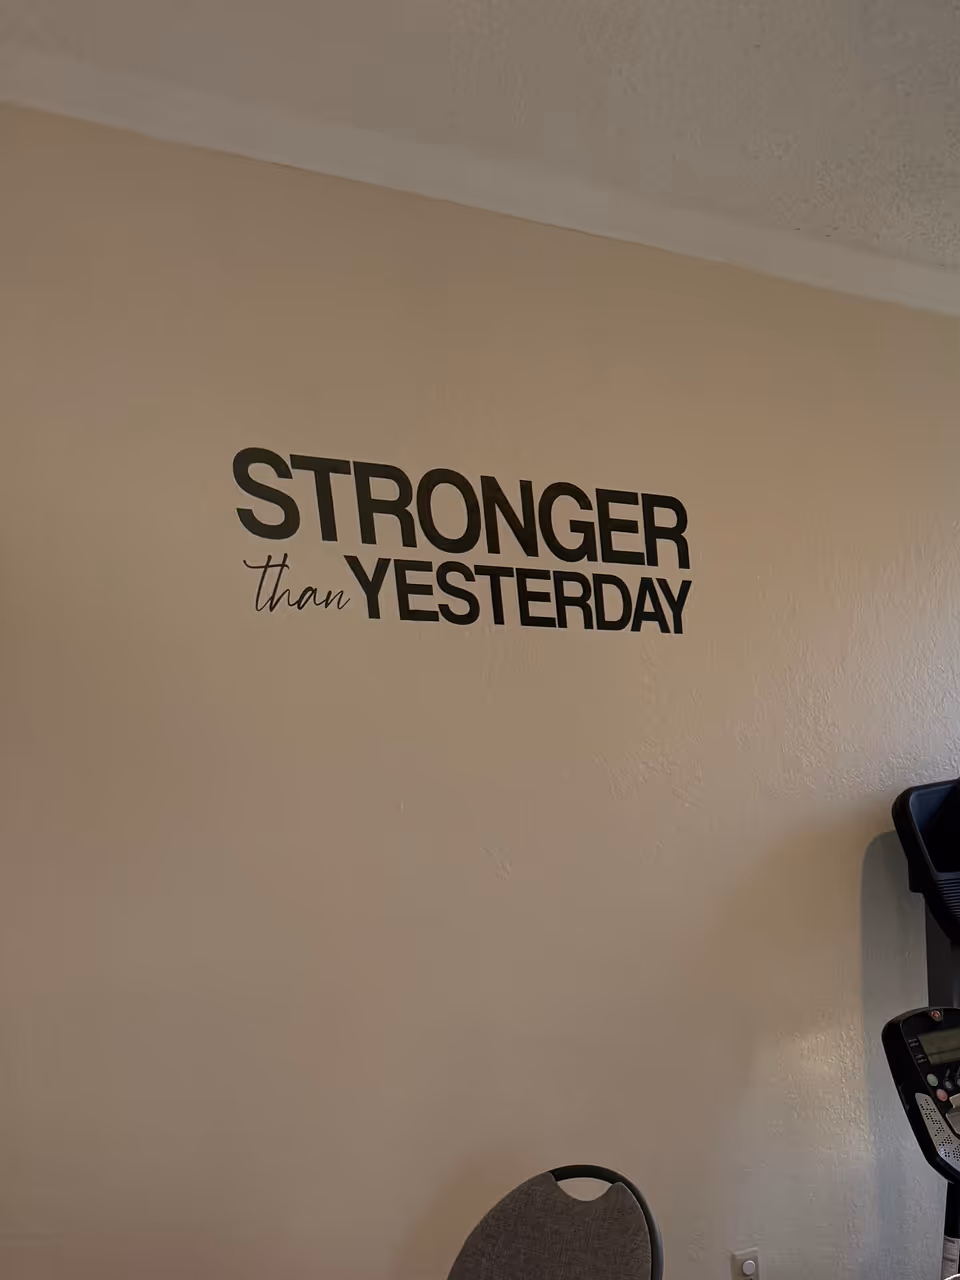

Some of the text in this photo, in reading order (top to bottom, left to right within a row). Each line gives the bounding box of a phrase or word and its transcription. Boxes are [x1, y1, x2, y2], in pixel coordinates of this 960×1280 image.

[232, 447, 691, 570] STRONGER
[243, 552, 693, 635] than YESTERDAY
